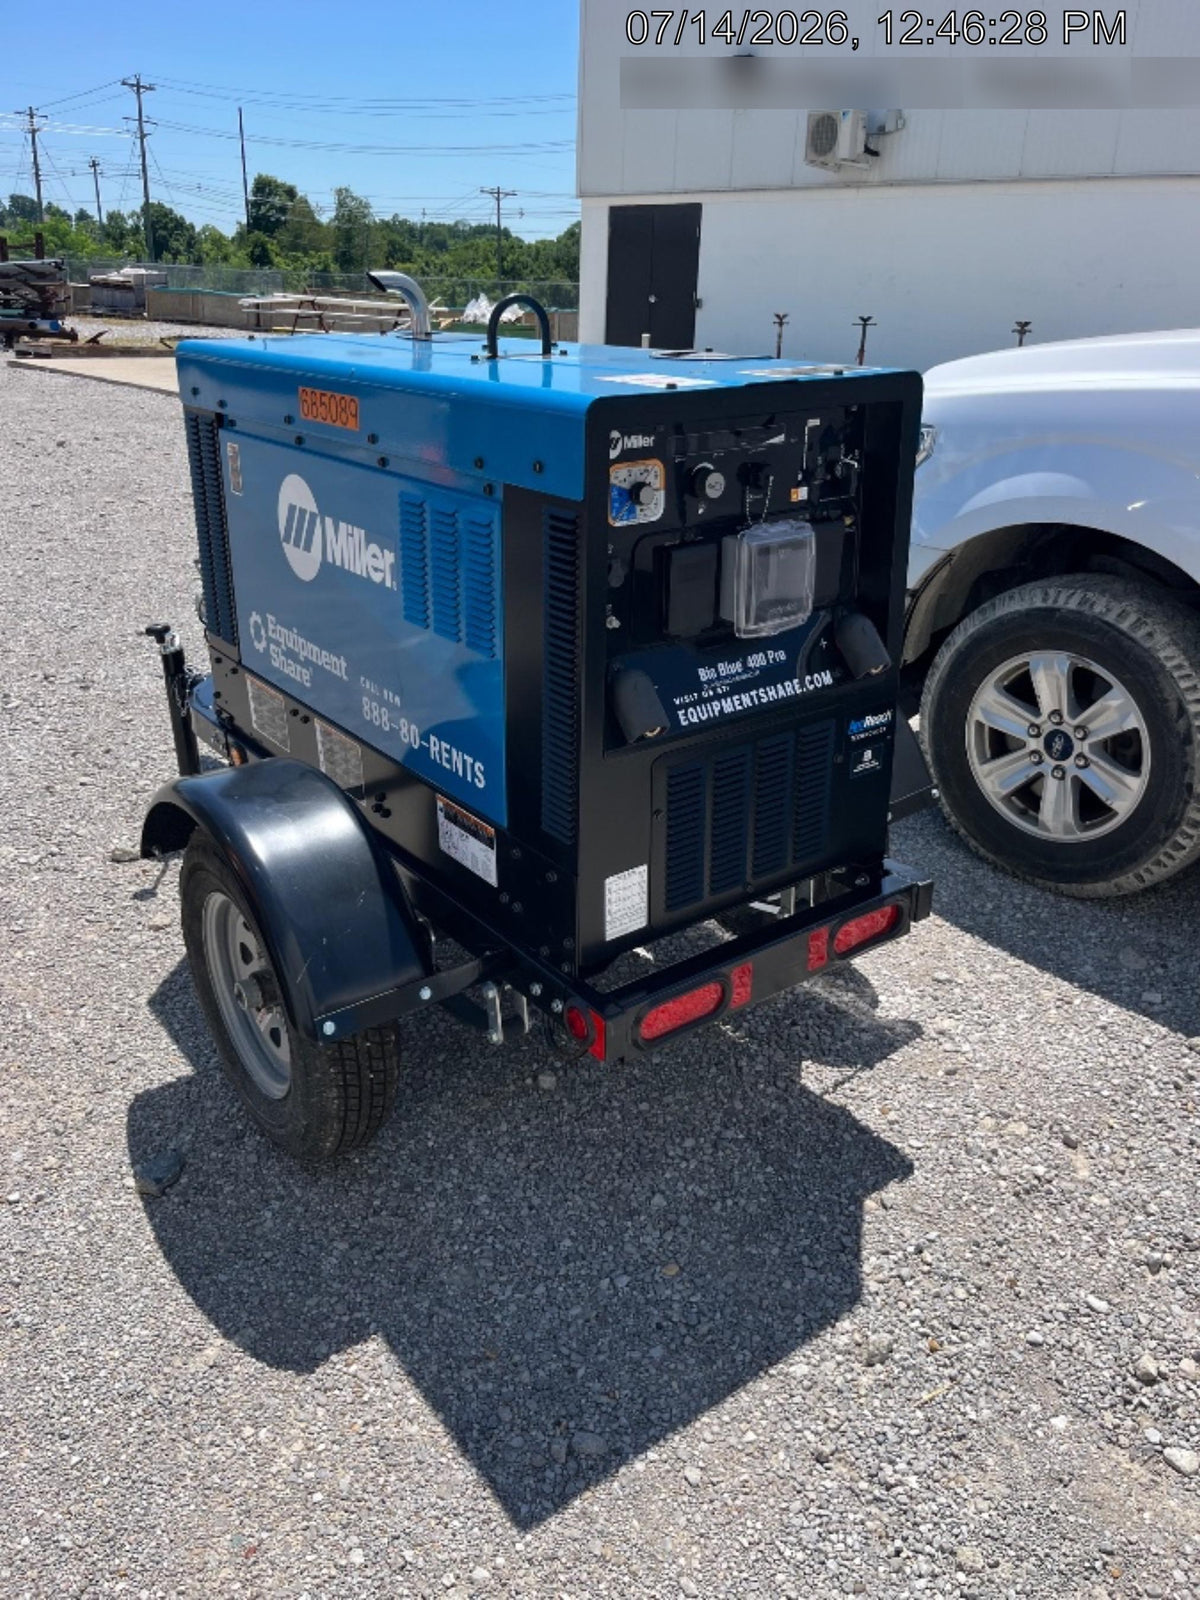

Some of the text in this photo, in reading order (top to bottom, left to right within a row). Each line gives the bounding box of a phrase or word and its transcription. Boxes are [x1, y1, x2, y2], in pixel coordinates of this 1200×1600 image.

[301, 388, 358, 429] 685089
[622, 434, 655, 450] Miller
[324, 516, 395, 589] Miller
[266, 613, 348, 681] Equipment
[269, 643, 312, 687] Share
[677, 670, 833, 727] EQUIPMENTSHARE.COM
[362, 696, 486, 789] 888-80-RENTS
